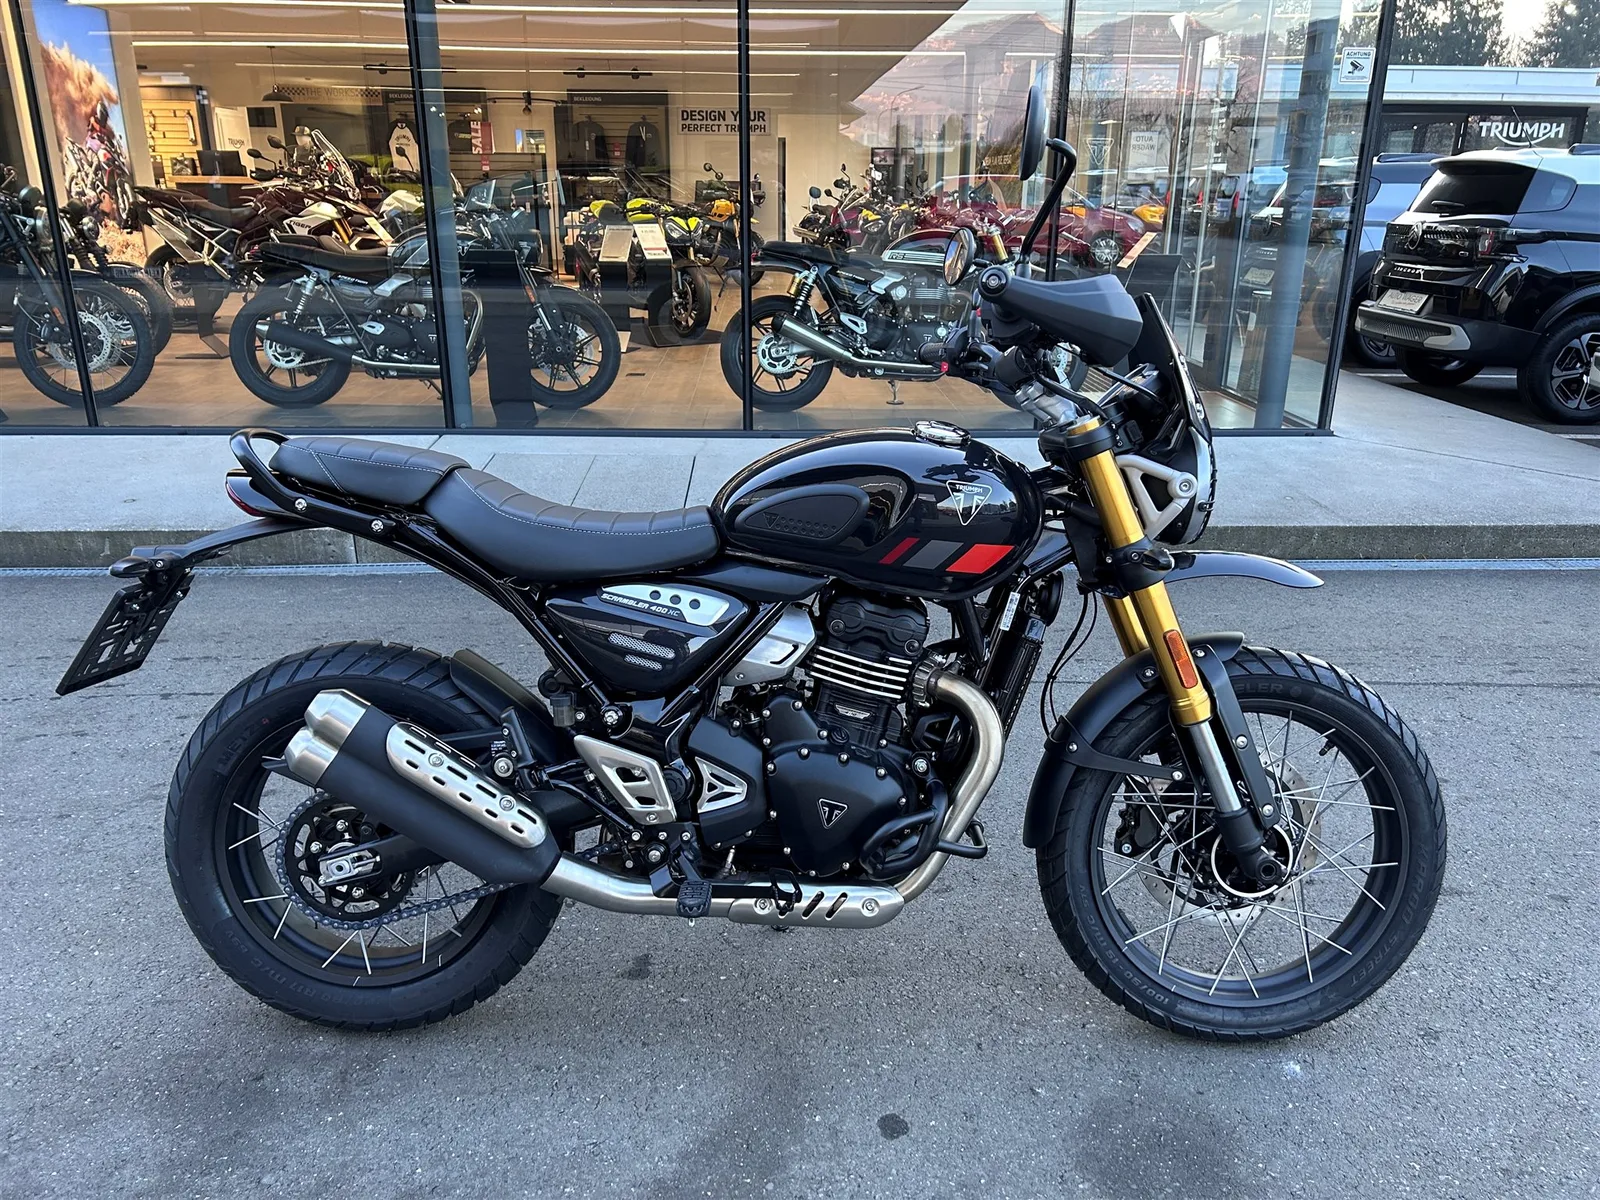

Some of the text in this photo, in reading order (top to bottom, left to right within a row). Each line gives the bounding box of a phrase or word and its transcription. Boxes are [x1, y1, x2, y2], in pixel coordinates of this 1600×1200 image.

[681, 110, 766, 122] DESIGN YUR
[681, 123, 722, 132] PERFECT
[1479, 121, 1565, 146] TRIUMPH
[470, 121, 482, 154] SALE
[288, 220, 312, 229] TIGER
[955, 484, 983, 494] TRIUMPH
[600, 592, 681, 617] SCRAMBLER 400 XC
[1234, 682, 1284, 694] ELER
[1350, 931, 1400, 988] STREET
